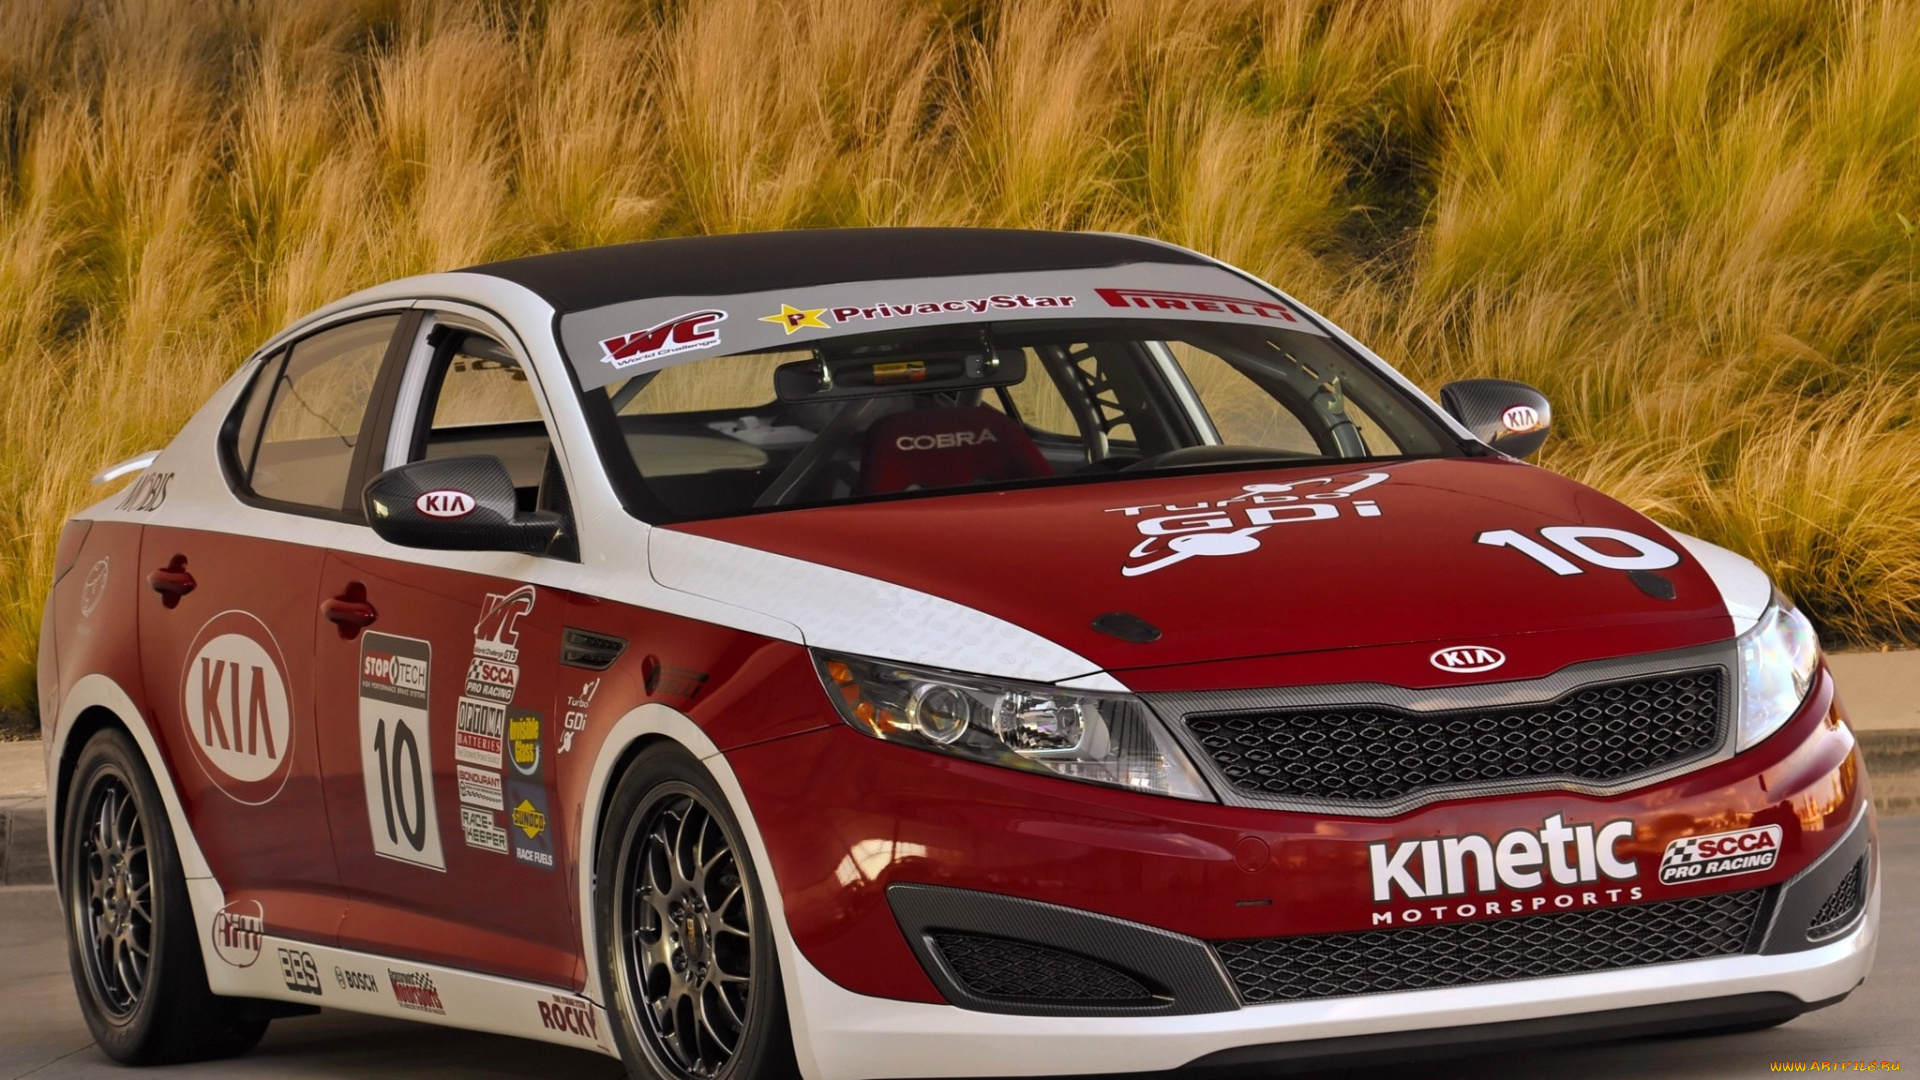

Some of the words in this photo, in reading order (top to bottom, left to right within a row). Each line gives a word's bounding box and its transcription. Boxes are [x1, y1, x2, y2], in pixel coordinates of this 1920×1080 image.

[831, 295, 1076, 323] PrivacyStar
[1094, 288, 1298, 323] PIRELLI
[601, 311, 718, 361] WC
[618, 353, 656, 366] World
[658, 340, 717, 356] Challenge
[1507, 410, 1535, 427] KIA
[896, 429, 997, 450] COBRA
[114, 472, 175, 512] MOBIS
[426, 495, 466, 512] KIA
[1475, 525, 1681, 577] 10
[504, 650, 518, 661] GTS
[1442, 649, 1496, 667] KIA
[364, 656, 390, 678] STOP
[399, 663, 426, 686] TECH
[482, 664, 515, 685] SCCA
[466, 682, 482, 693] PRO
[482, 685, 513, 699] RACING
[201, 656, 277, 761] KIA
[458, 701, 504, 738] OPTIMA
[457, 732, 501, 752] BATTERIES
[374, 718, 426, 852] 10
[459, 770, 501, 788] BONDURANT
[514, 809, 545, 829] SUNOCO
[467, 829, 505, 848] KEEPER
[1697, 831, 1776, 859] SCCA
[516, 847, 534, 861] RACE
[534, 852, 553, 866] FUELS
[1663, 864, 1702, 881] PRO
[1705, 852, 1774, 874] RACING
[1372, 887, 1643, 926] MOTORSPORTS
[278, 947, 323, 996] BBS
[345, 970, 379, 992] BOSCH
[537, 1000, 598, 1040] ROCKY
